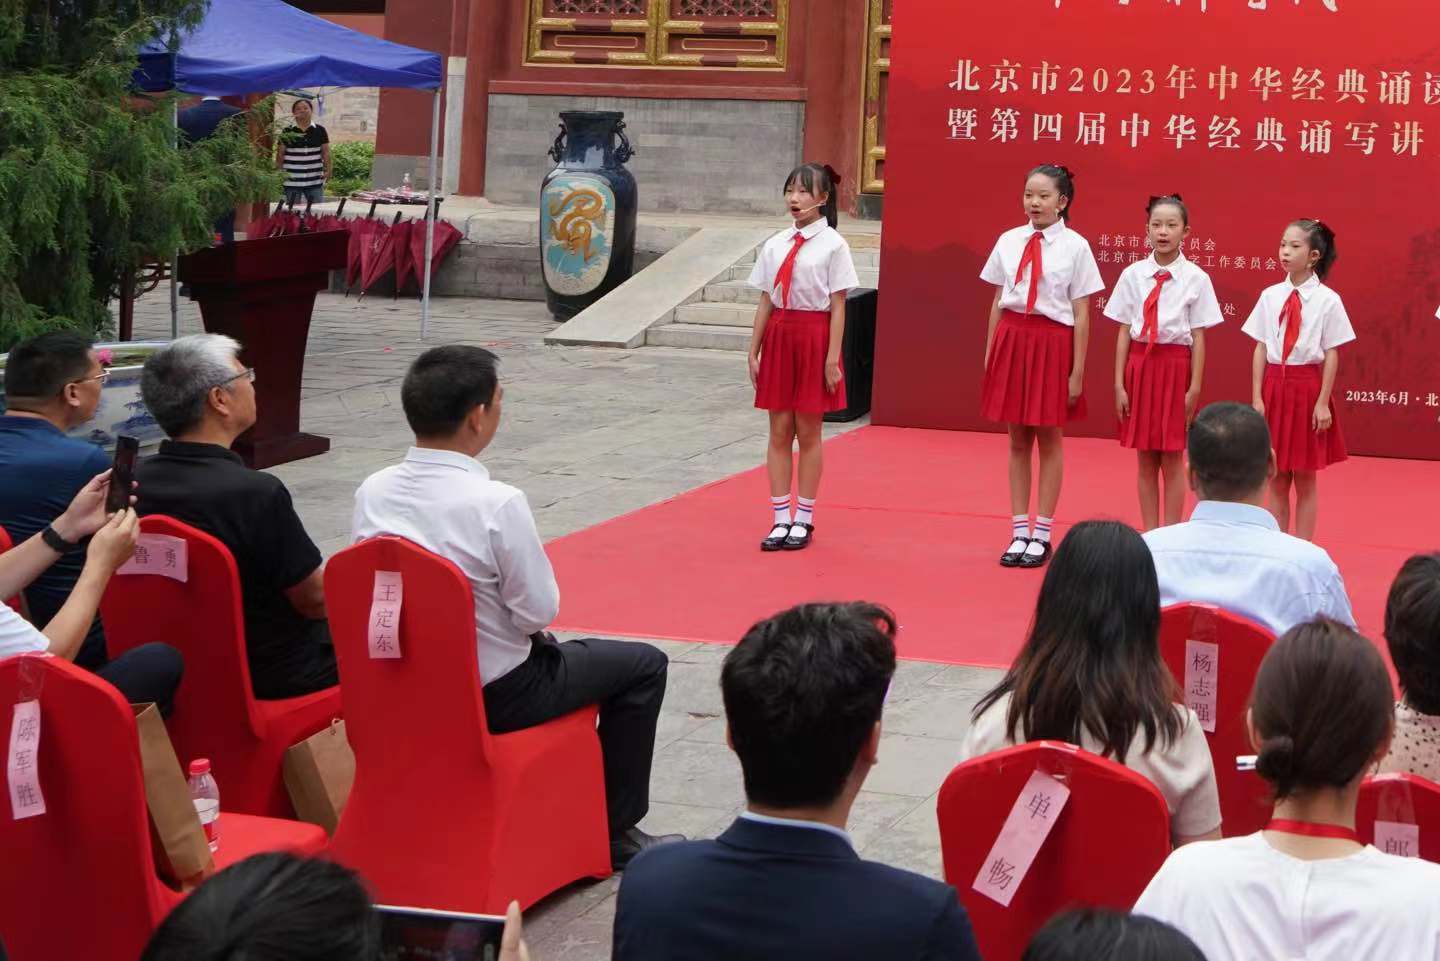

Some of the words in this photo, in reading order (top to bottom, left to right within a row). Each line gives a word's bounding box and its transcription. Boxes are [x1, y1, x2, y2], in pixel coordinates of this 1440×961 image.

[375, 583, 398, 653] 王定东
[1192, 651, 1212, 723] 杨志强
[988, 791, 1052, 891] 单畅
